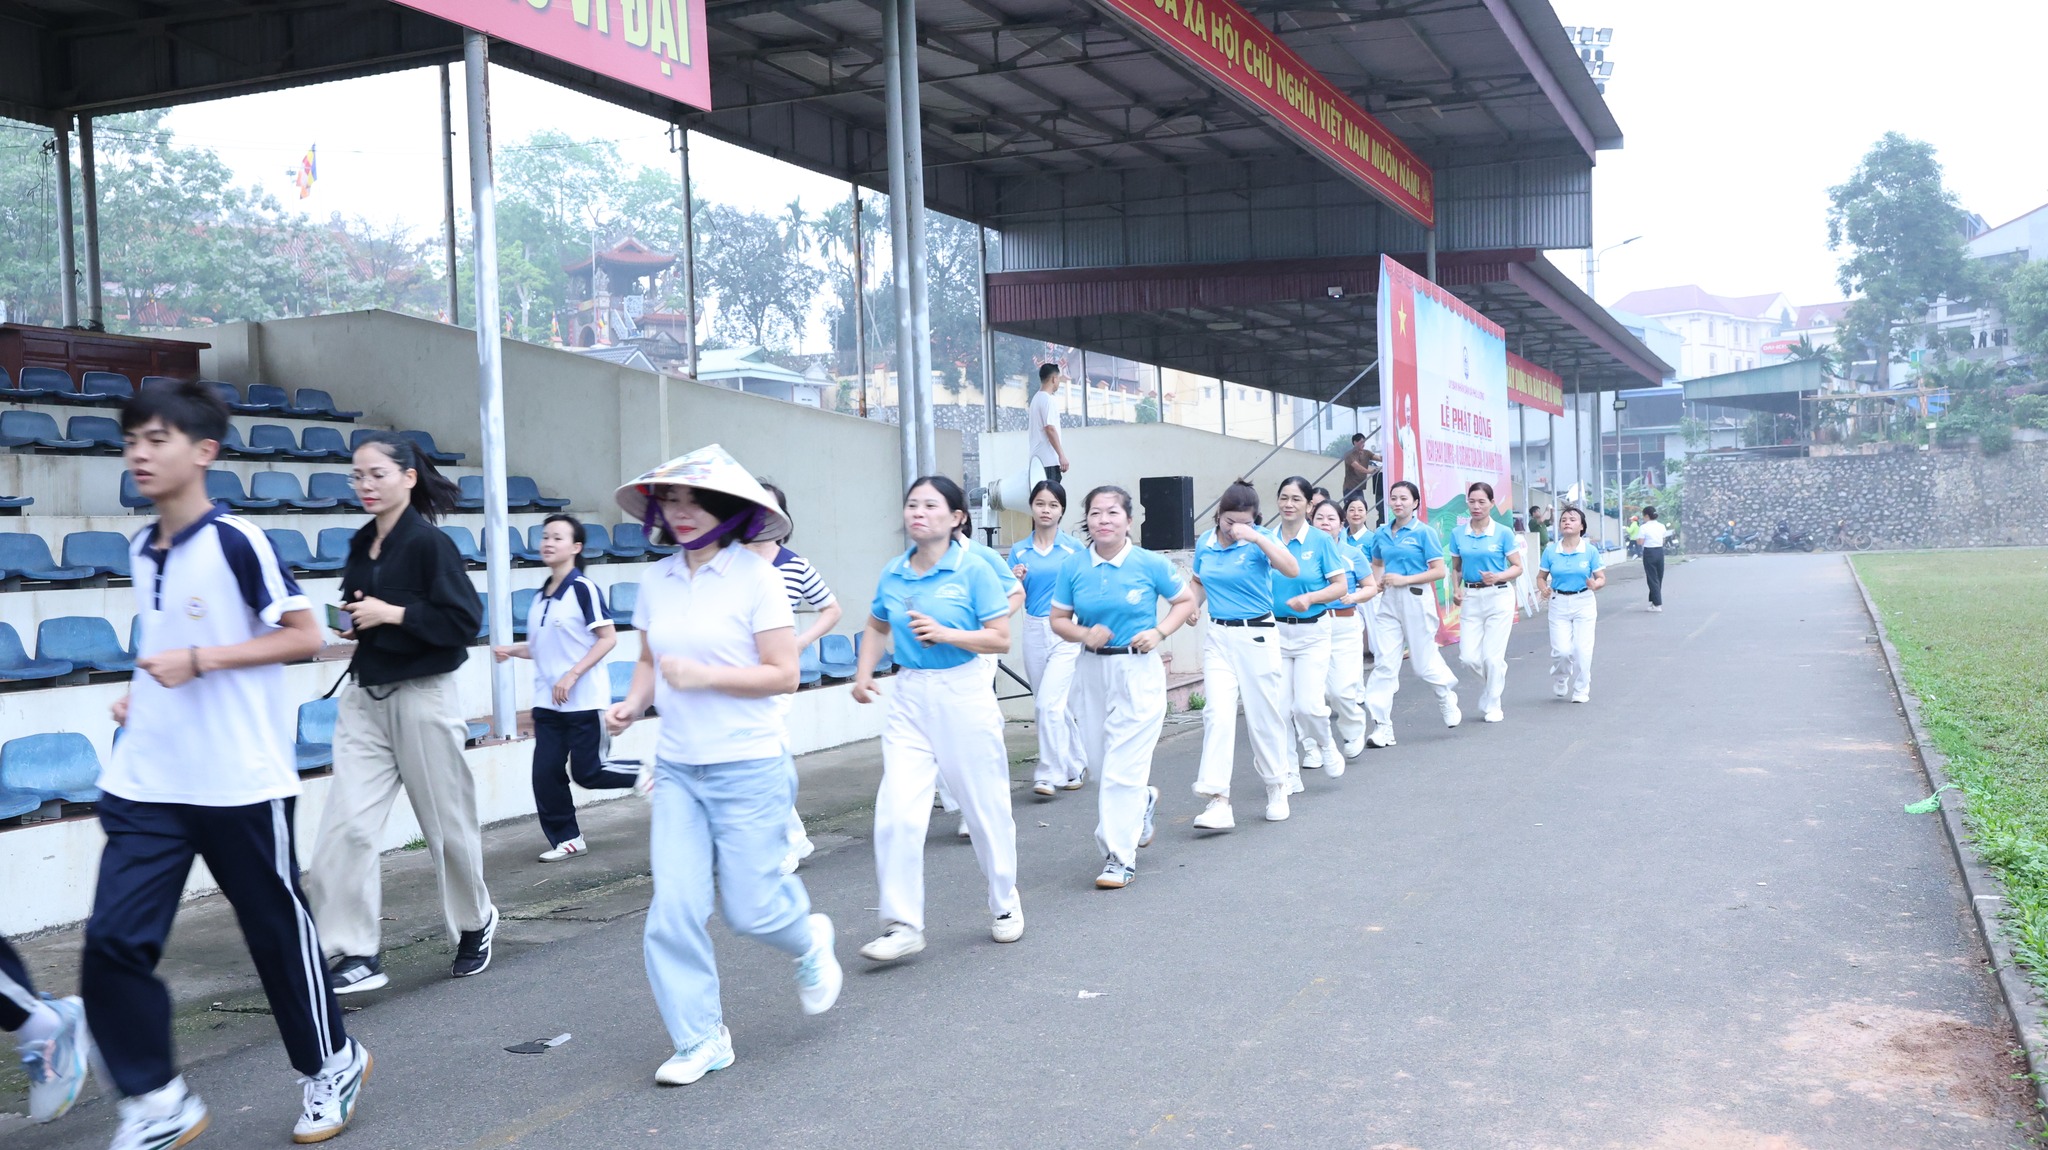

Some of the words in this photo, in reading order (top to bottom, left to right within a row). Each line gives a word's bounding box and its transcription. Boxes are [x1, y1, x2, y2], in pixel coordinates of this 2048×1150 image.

[1211, 12, 1240, 70] HỘI
[1243, 38, 1273, 89] CHỦ
[1276, 63, 1317, 124] NGHĨA
[1318, 97, 1343, 145] VIỆT
[1344, 118, 1369, 161] NAM
[1371, 138, 1398, 183] MUÔN
